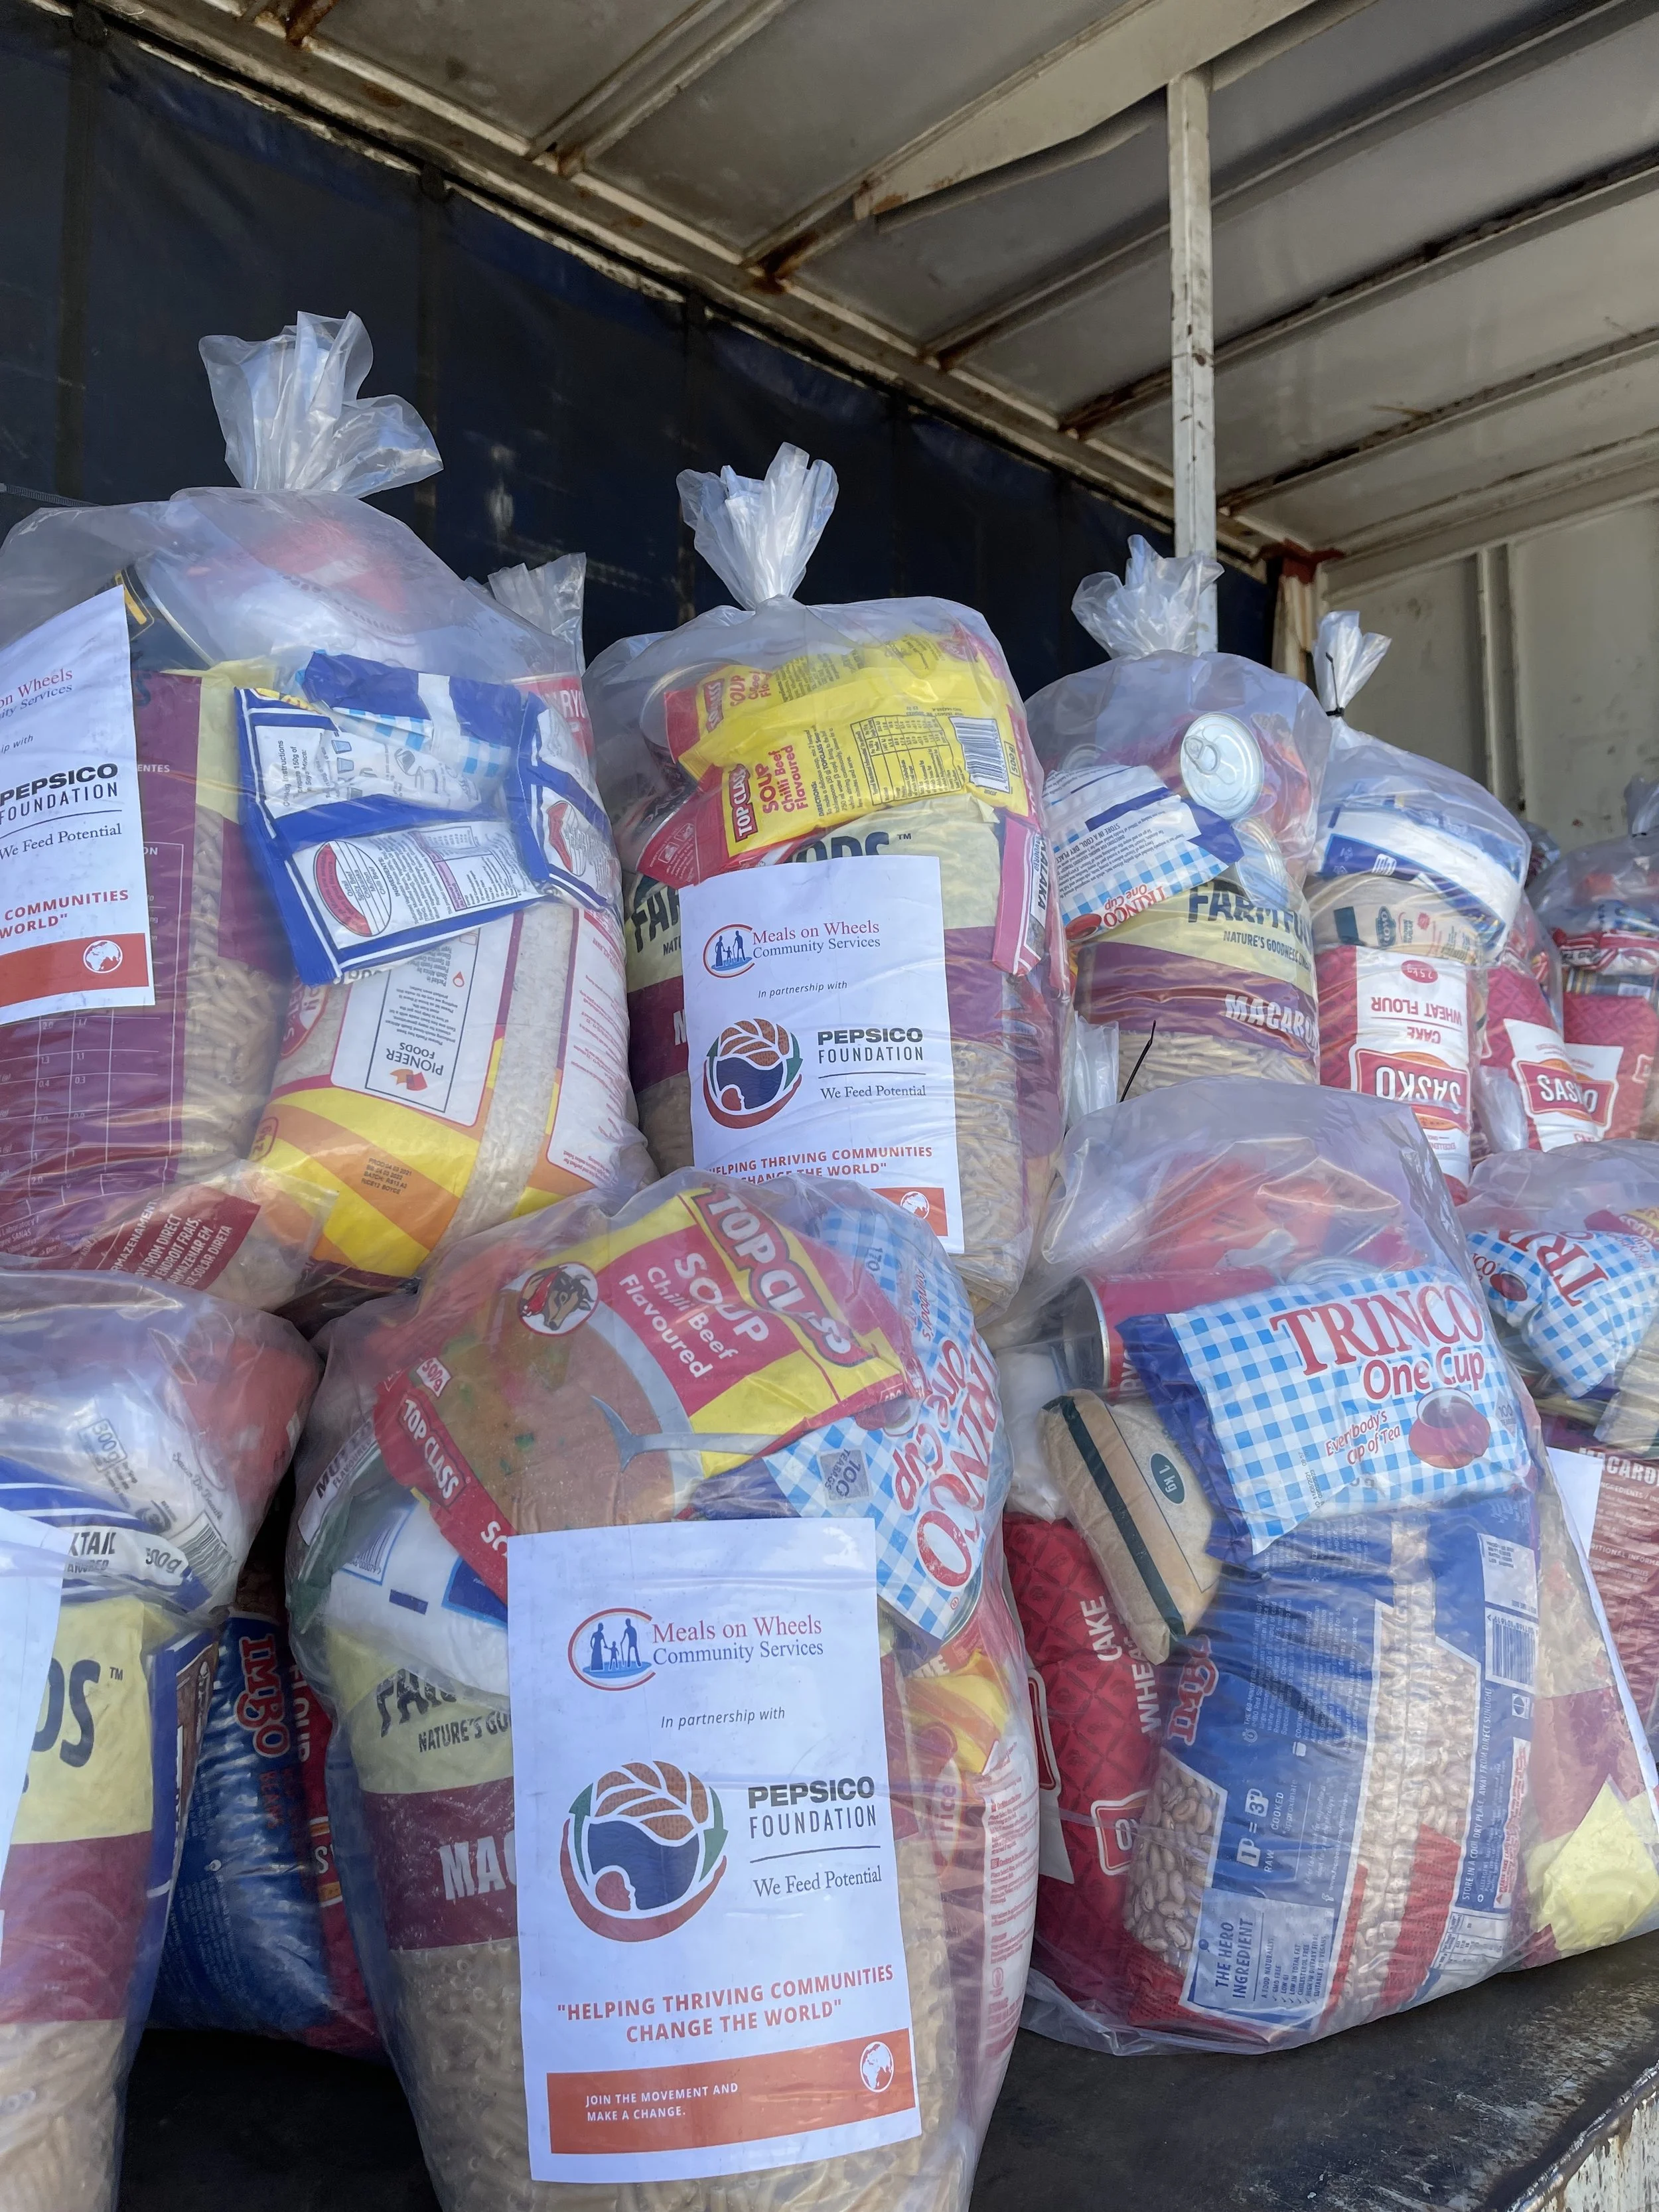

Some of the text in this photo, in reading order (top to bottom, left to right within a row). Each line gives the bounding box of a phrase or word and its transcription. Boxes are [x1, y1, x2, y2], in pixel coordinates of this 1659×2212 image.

[18, 668, 73, 698] Wheels
[20, 684, 72, 710] Services
[13, 734, 34, 749] with
[277, 740, 289, 782] Instructions
[292, 755, 301, 769] 150g
[0, 763, 118, 807] PEPSICO
[755, 763, 779, 814] SOUP
[768, 749, 795, 812] Chilli Beef
[780, 745, 809, 810] Flavoured
[0, 782, 118, 825] FOUNDATION
[732, 765, 753, 837] TOP CLASS
[811, 781, 824, 816] DIRECTIONS:
[0, 823, 123, 860] We Feed Potential
[1104, 823, 1121, 836] STORE
[1070, 846, 1080, 855] DRY
[5, 889, 129, 921] COMMUNITIES
[1104, 884, 1147, 911] One Cup
[0, 913, 68, 939] WORLD"
[753, 920, 880, 945] Meals on Wheels
[753, 936, 881, 959] Community Services
[1223, 930, 1299, 962] NATURE'S GOODNESS
[770, 983, 824, 999] partnership
[828, 981, 847, 990] with
[1371, 996, 1463, 1026] WHEAT FLOUR
[399, 1043, 435, 1059] FOODS
[818, 1028, 923, 1045] PEPSICO
[1407, 1026, 1441, 1045] CAKE
[386, 1048, 444, 1076] PIONEER
[819, 1046, 923, 1063] FOUNDATION
[820, 1084, 926, 1099] We Feed Potential
[1375, 1066, 1461, 1115] SASKO
[761, 1146, 932, 1167] THRIVING COMMUNITIES
[827, 1163, 887, 1177] WORLD"
[145, 1213, 182, 1268] FROM DIRECT
[201, 1226, 214, 1241] EM
[707, 1194, 776, 1264] TOP
[159, 1217, 202, 1278] ENDROIT FRAIS,
[192, 1225, 232, 1279] SOLAR DIRETA
[648, 1266, 739, 1359] Chilli Beef
[674, 1252, 769, 1342] SOUP
[618, 1274, 713, 1378] Flavoured
[1269, 1284, 1484, 1376] TRINCO
[1363, 1346, 1484, 1400] One Cup
[403, 1399, 459, 1499] TOP CLASS
[1326, 1410, 1387, 1456] Everybody's
[1368, 1426, 1400, 1453] of Tea
[824, 1448, 851, 1491] TEABAGS
[839, 1458, 862, 1497] 100
[892, 1422, 943, 1512] Cup
[1161, 1475, 1179, 1494] kg
[652, 1614, 823, 1644] Meals on Wheels
[1080, 1595, 1123, 1662] CAKE
[653, 1638, 824, 1666] Community Services
[234, 1635, 291, 1758] IMBO
[1483, 1688, 1494, 1730] SUNLIGHT
[418, 1716, 483, 1753] NATURE'S
[661, 1706, 786, 1731] In partnership with
[1481, 1731, 1491, 1755] DIRECT
[1480, 1757, 1488, 1778] FROM
[748, 1775, 875, 1809] PEPSICO
[1478, 1778, 1488, 1797] AWAY
[749, 1805, 877, 1839] FOUNDATION
[1271, 1791, 1284, 1830] COOKED
[1473, 1822, 1482, 1839] DRY
[1264, 1850, 1275, 1873] RAW
[1466, 1868, 1474, 1878] IN
[753, 1864, 882, 1897] We Feed Potential
[1462, 1879, 1472, 1900] STORE
[1215, 1922, 1234, 1988] THE HERO
[1232, 1918, 1254, 1999] INGREDIENT
[1291, 1957, 1301, 1974] TOTAL
[1301, 1943, 1310, 1956] FREE
[557, 1964, 894, 2021] "HELPING THRIVING COMMUNITIES
[626, 1998, 842, 2043] CHANGE THE WORLD"
[585, 2082, 739, 2108] JOIN THE MOVEMENT AND
[587, 2105, 686, 2122] MAKE A CHANGE.
